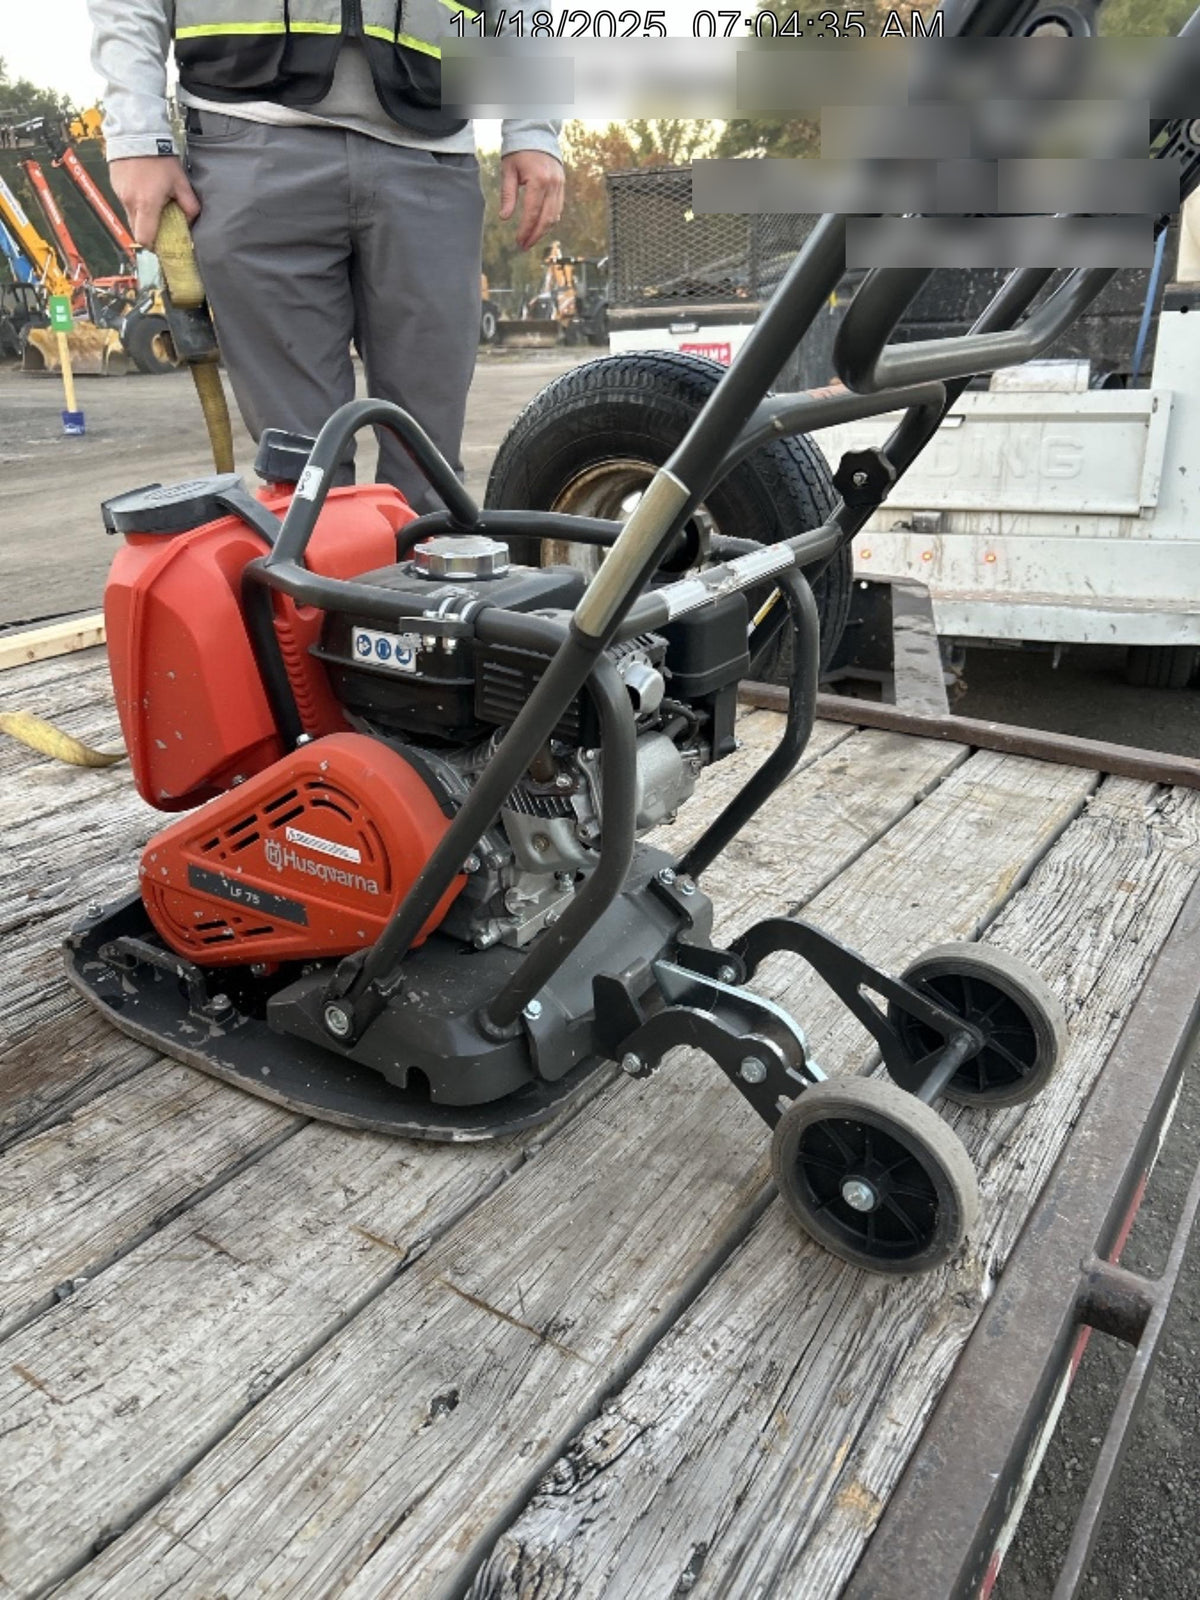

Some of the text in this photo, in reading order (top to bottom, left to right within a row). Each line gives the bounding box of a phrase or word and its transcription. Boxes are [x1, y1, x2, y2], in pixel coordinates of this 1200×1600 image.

[283, 848, 379, 895] Husqvarna
[230, 886, 260, 905] LF 75
